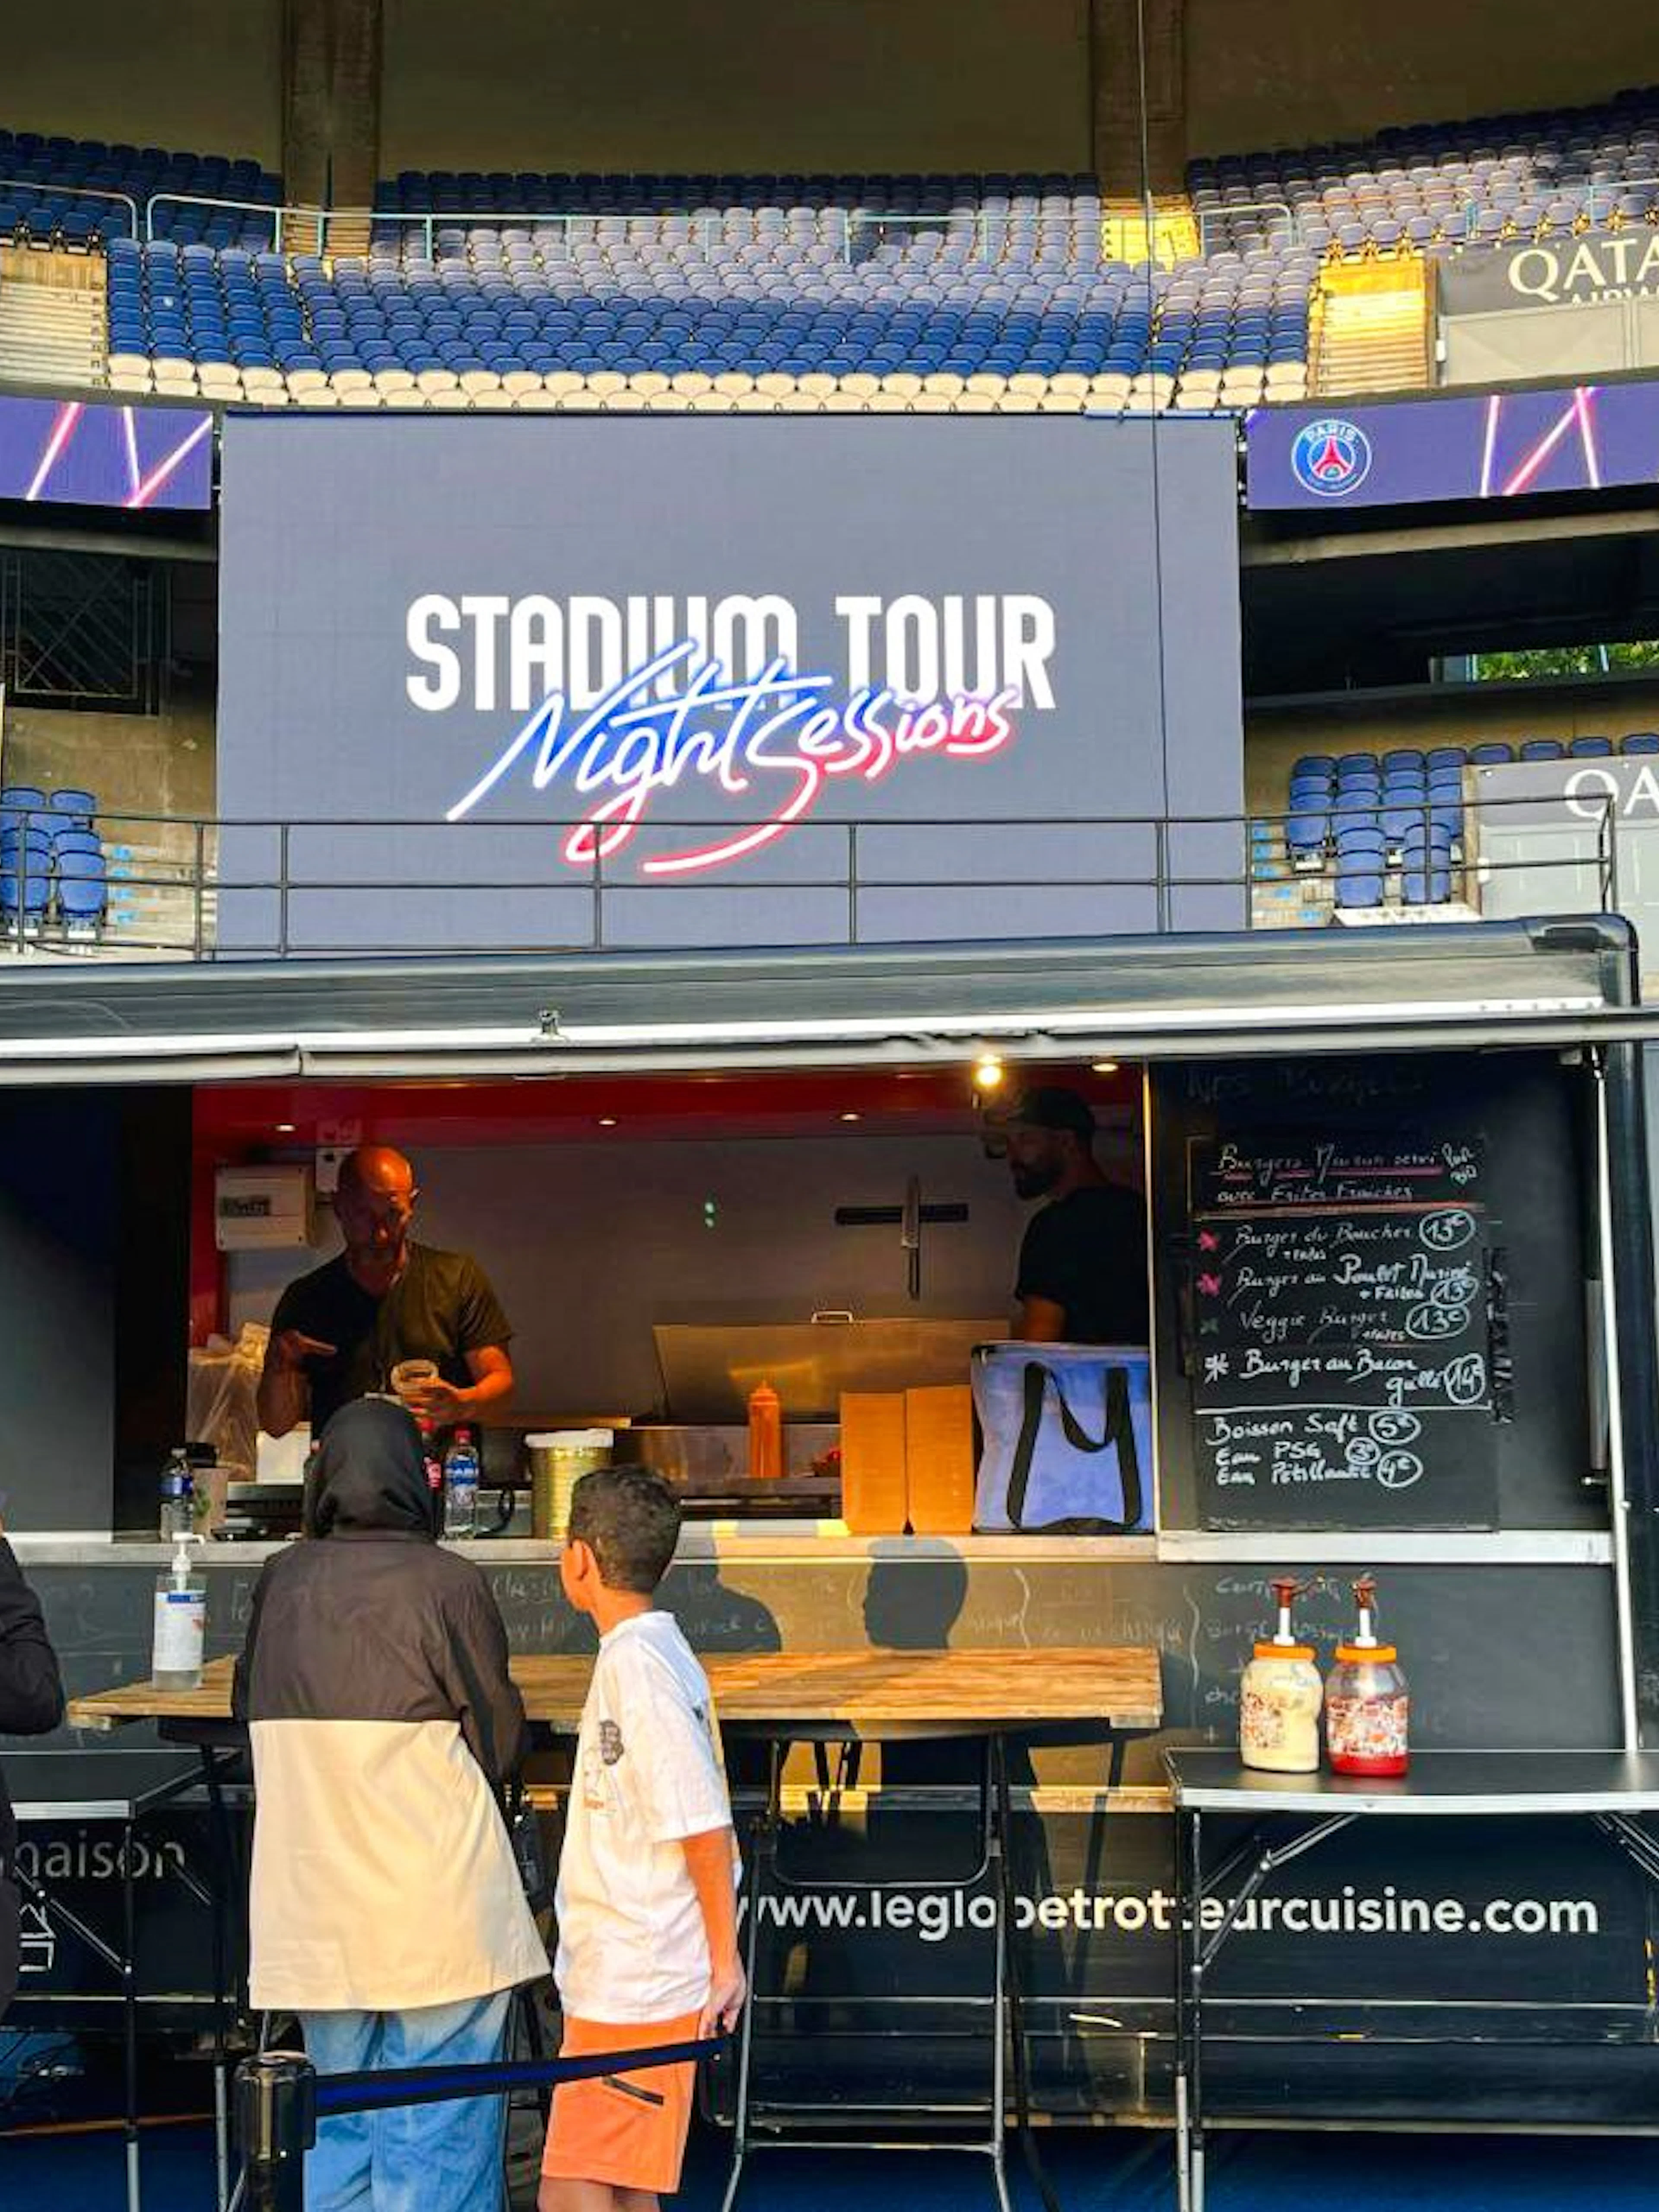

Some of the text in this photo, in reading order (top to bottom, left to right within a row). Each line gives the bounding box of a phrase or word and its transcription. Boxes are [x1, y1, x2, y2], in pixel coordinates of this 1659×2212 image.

[406, 594, 1057, 711] STADIUM TOUR
[445, 636, 1018, 873] Night Sessions
[1239, 1348, 1321, 1389] Burger
[1205, 1416, 1294, 1446] Boisson
[1304, 1412, 1358, 1443] Soft
[1274, 1440, 1322, 1460] PSG
[735, 1885, 1598, 1942] ww.legloetroteurcuisine.com
